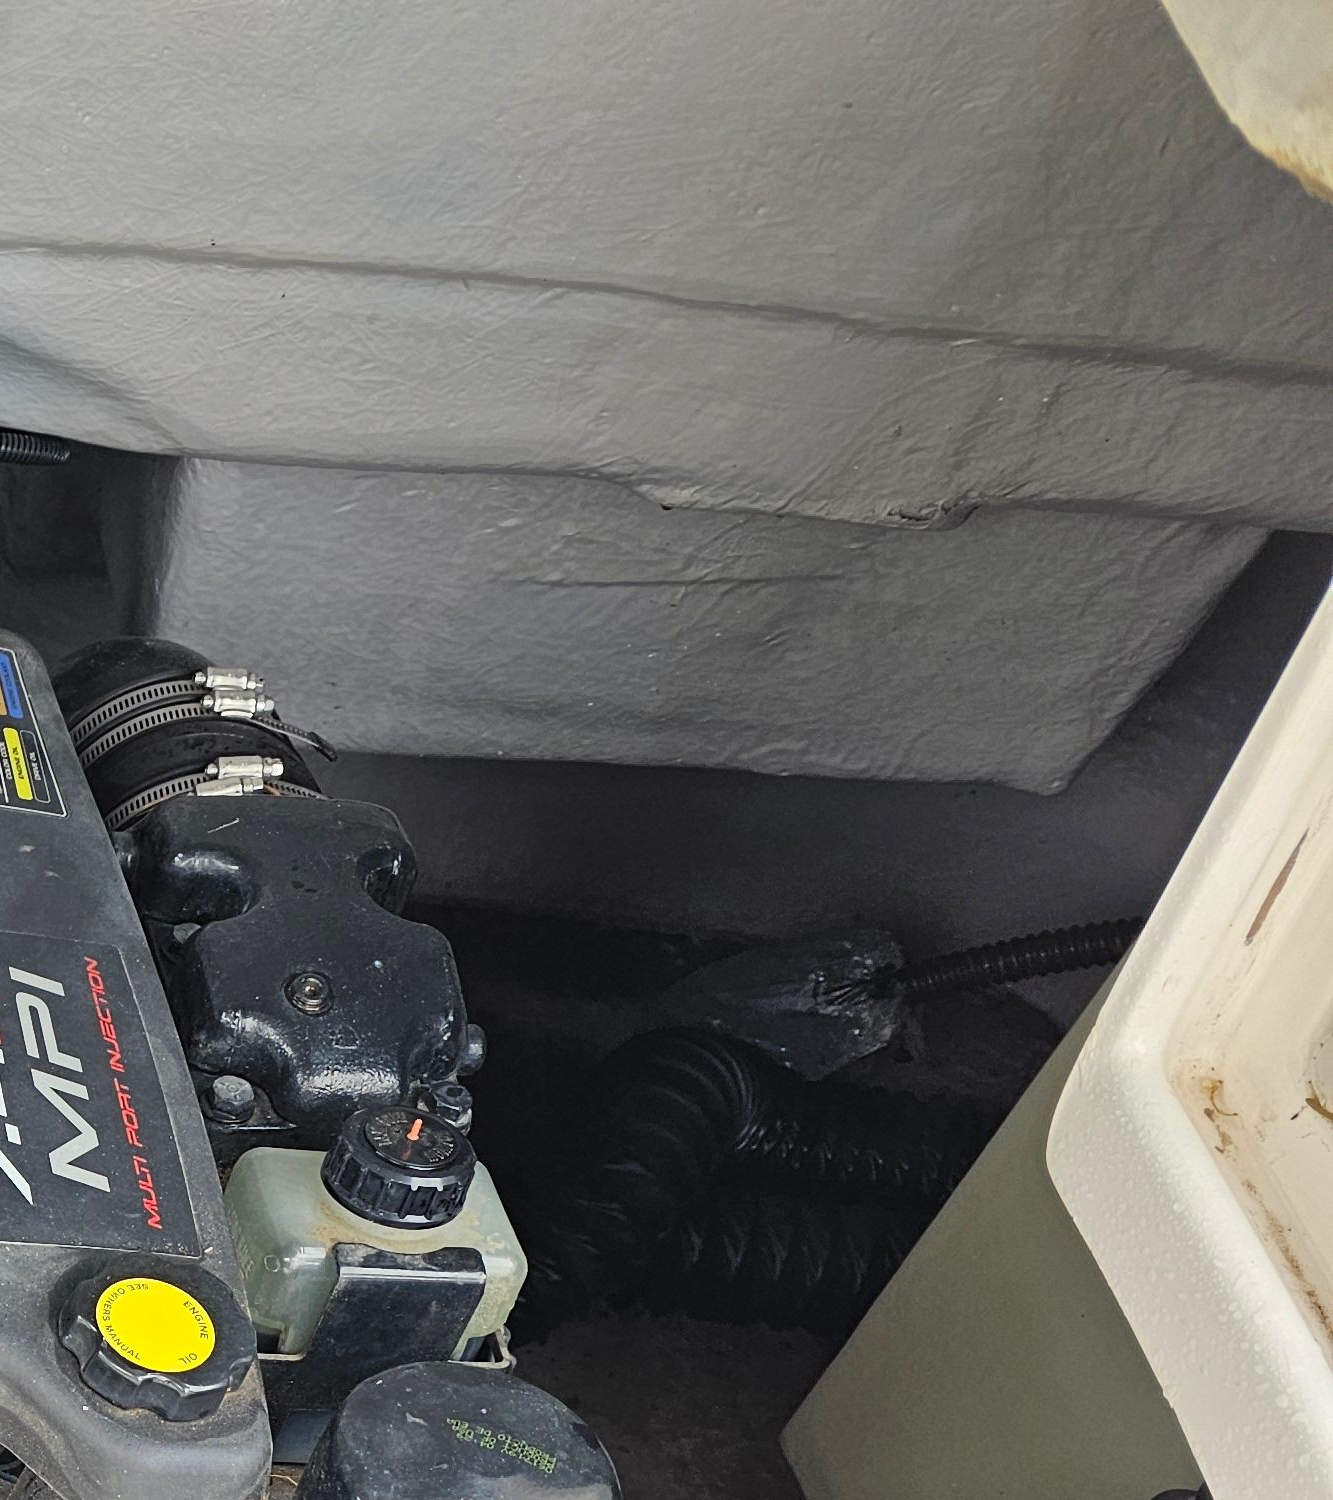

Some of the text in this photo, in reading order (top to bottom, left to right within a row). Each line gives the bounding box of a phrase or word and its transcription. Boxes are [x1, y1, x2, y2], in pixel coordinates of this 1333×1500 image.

[12, 756, 26, 779] ENGINE
[8, 966, 110, 1193] MPI
[84, 956, 162, 1230] MULTI PORT INJECTION
[105, 1325, 141, 1360] MANUAL
[179, 1301, 209, 1364] ENGINE OIL
